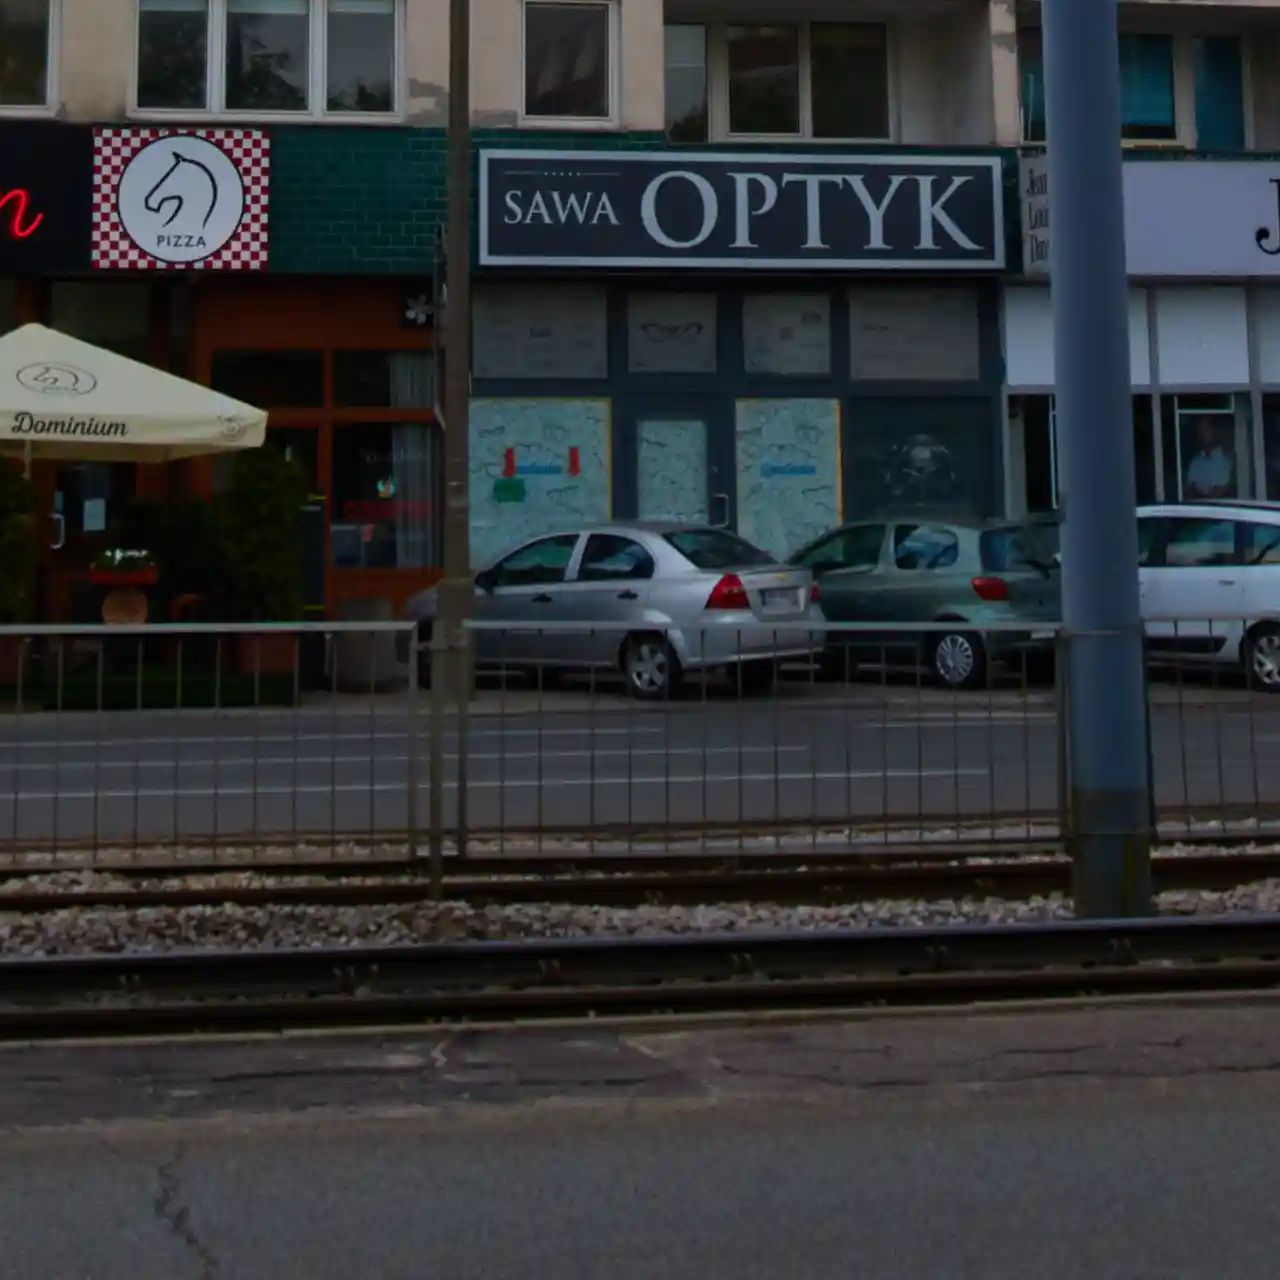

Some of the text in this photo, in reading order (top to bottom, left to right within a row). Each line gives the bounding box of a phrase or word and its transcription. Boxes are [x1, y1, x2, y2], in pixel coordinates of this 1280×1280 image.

[504, 171, 984, 250] SAWA OPTYK
[156, 235, 207, 248] PIZZA
[11, 411, 129, 438] Dominium
